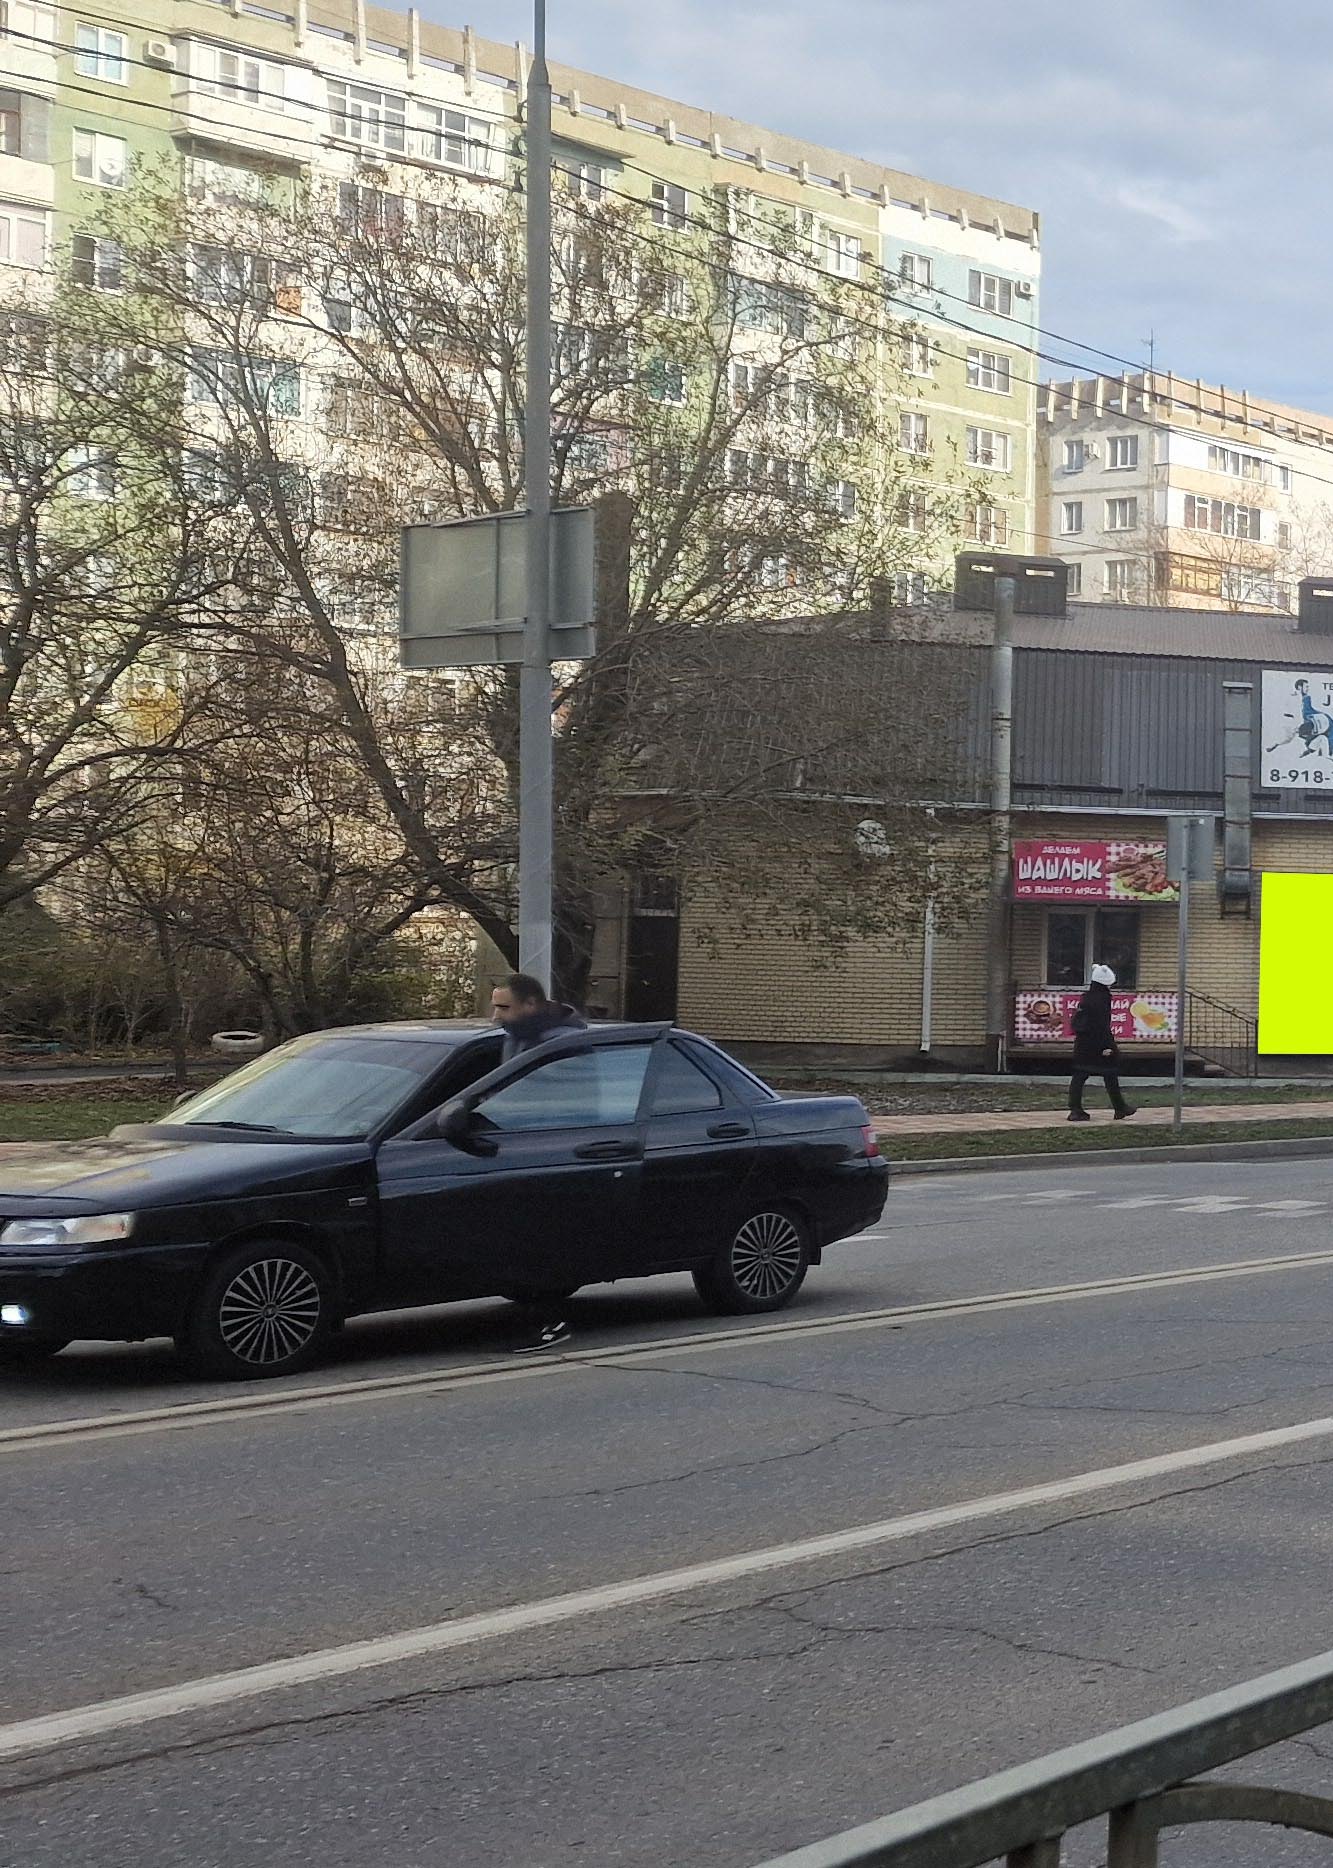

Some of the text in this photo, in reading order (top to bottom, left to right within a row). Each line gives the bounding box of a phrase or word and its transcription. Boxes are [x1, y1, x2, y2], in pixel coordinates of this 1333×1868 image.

[1042, 846, 1080, 855] ДЕЛАЕМ
[1018, 856, 1102, 881] ШАШЛЫК
[1018, 886, 1103, 895] ИЗ ВАШЕГО МЯСА
